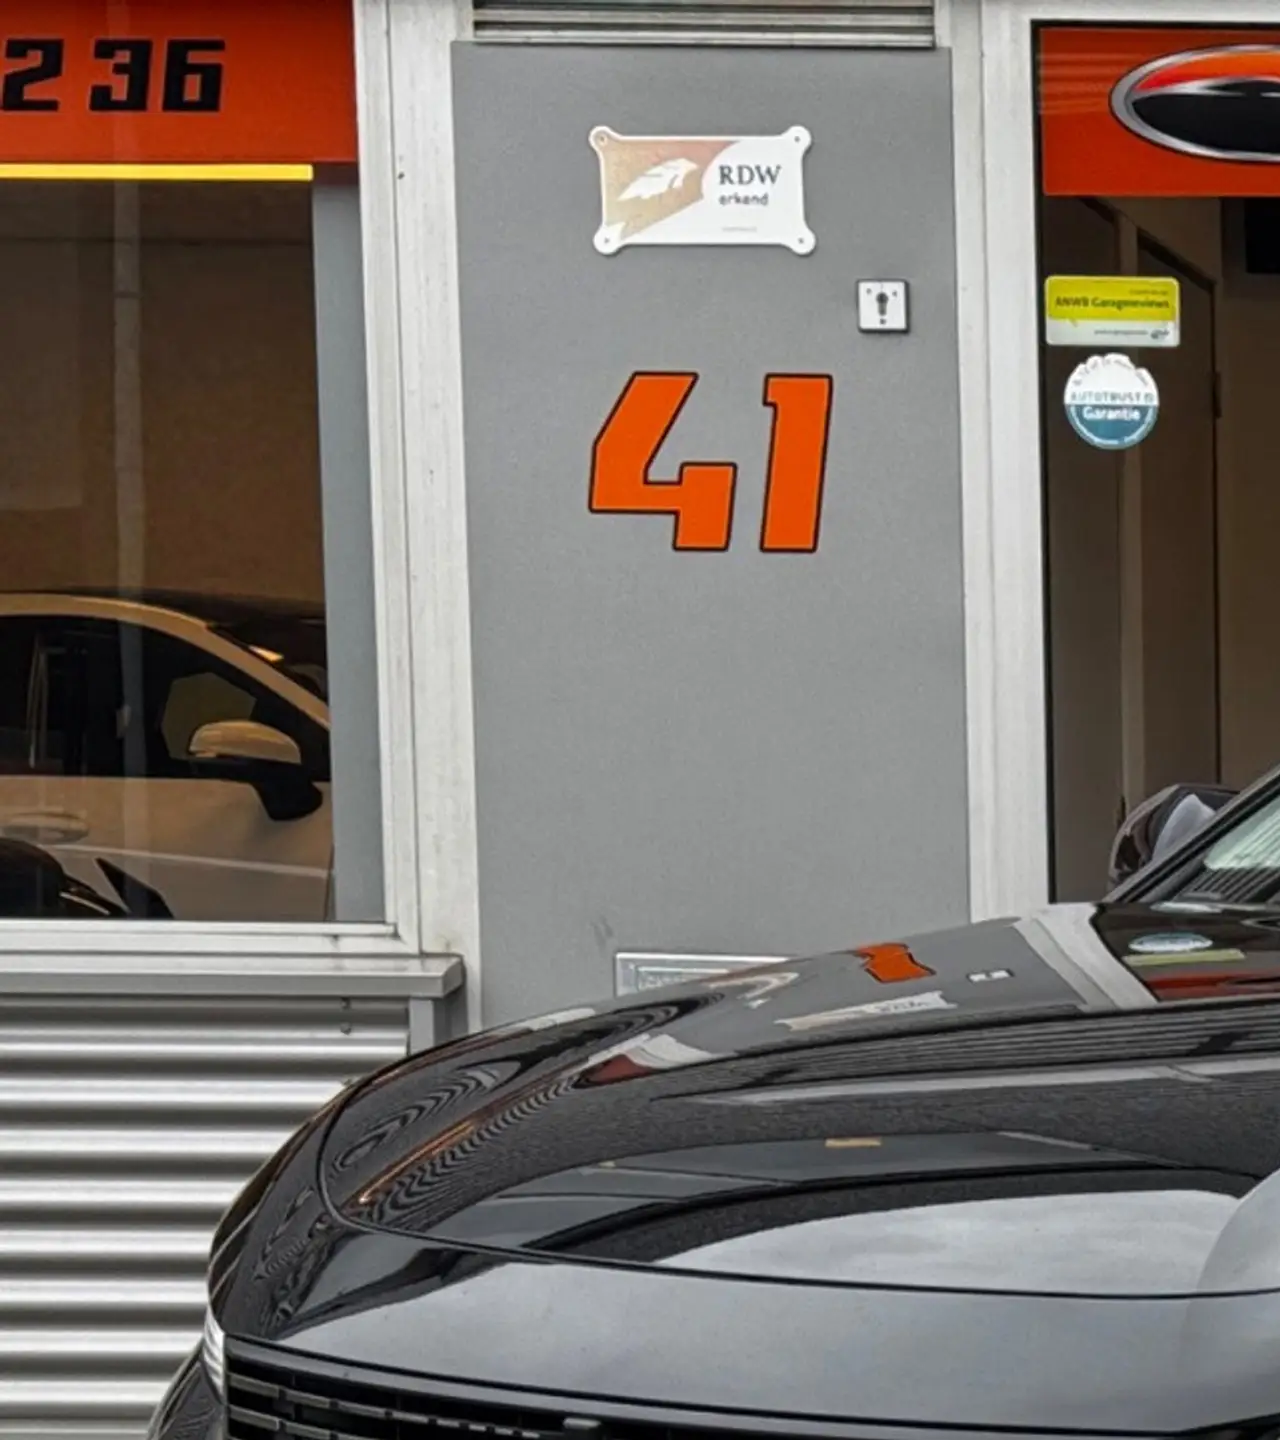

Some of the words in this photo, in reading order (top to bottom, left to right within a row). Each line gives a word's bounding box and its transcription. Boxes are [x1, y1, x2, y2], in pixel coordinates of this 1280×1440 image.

[89, 39, 226, 112] 36
[718, 164, 781, 186] RDW
[718, 192, 769, 207] erkend
[1082, 405, 1141, 420] Garantie
[589, 371, 833, 552] 41
